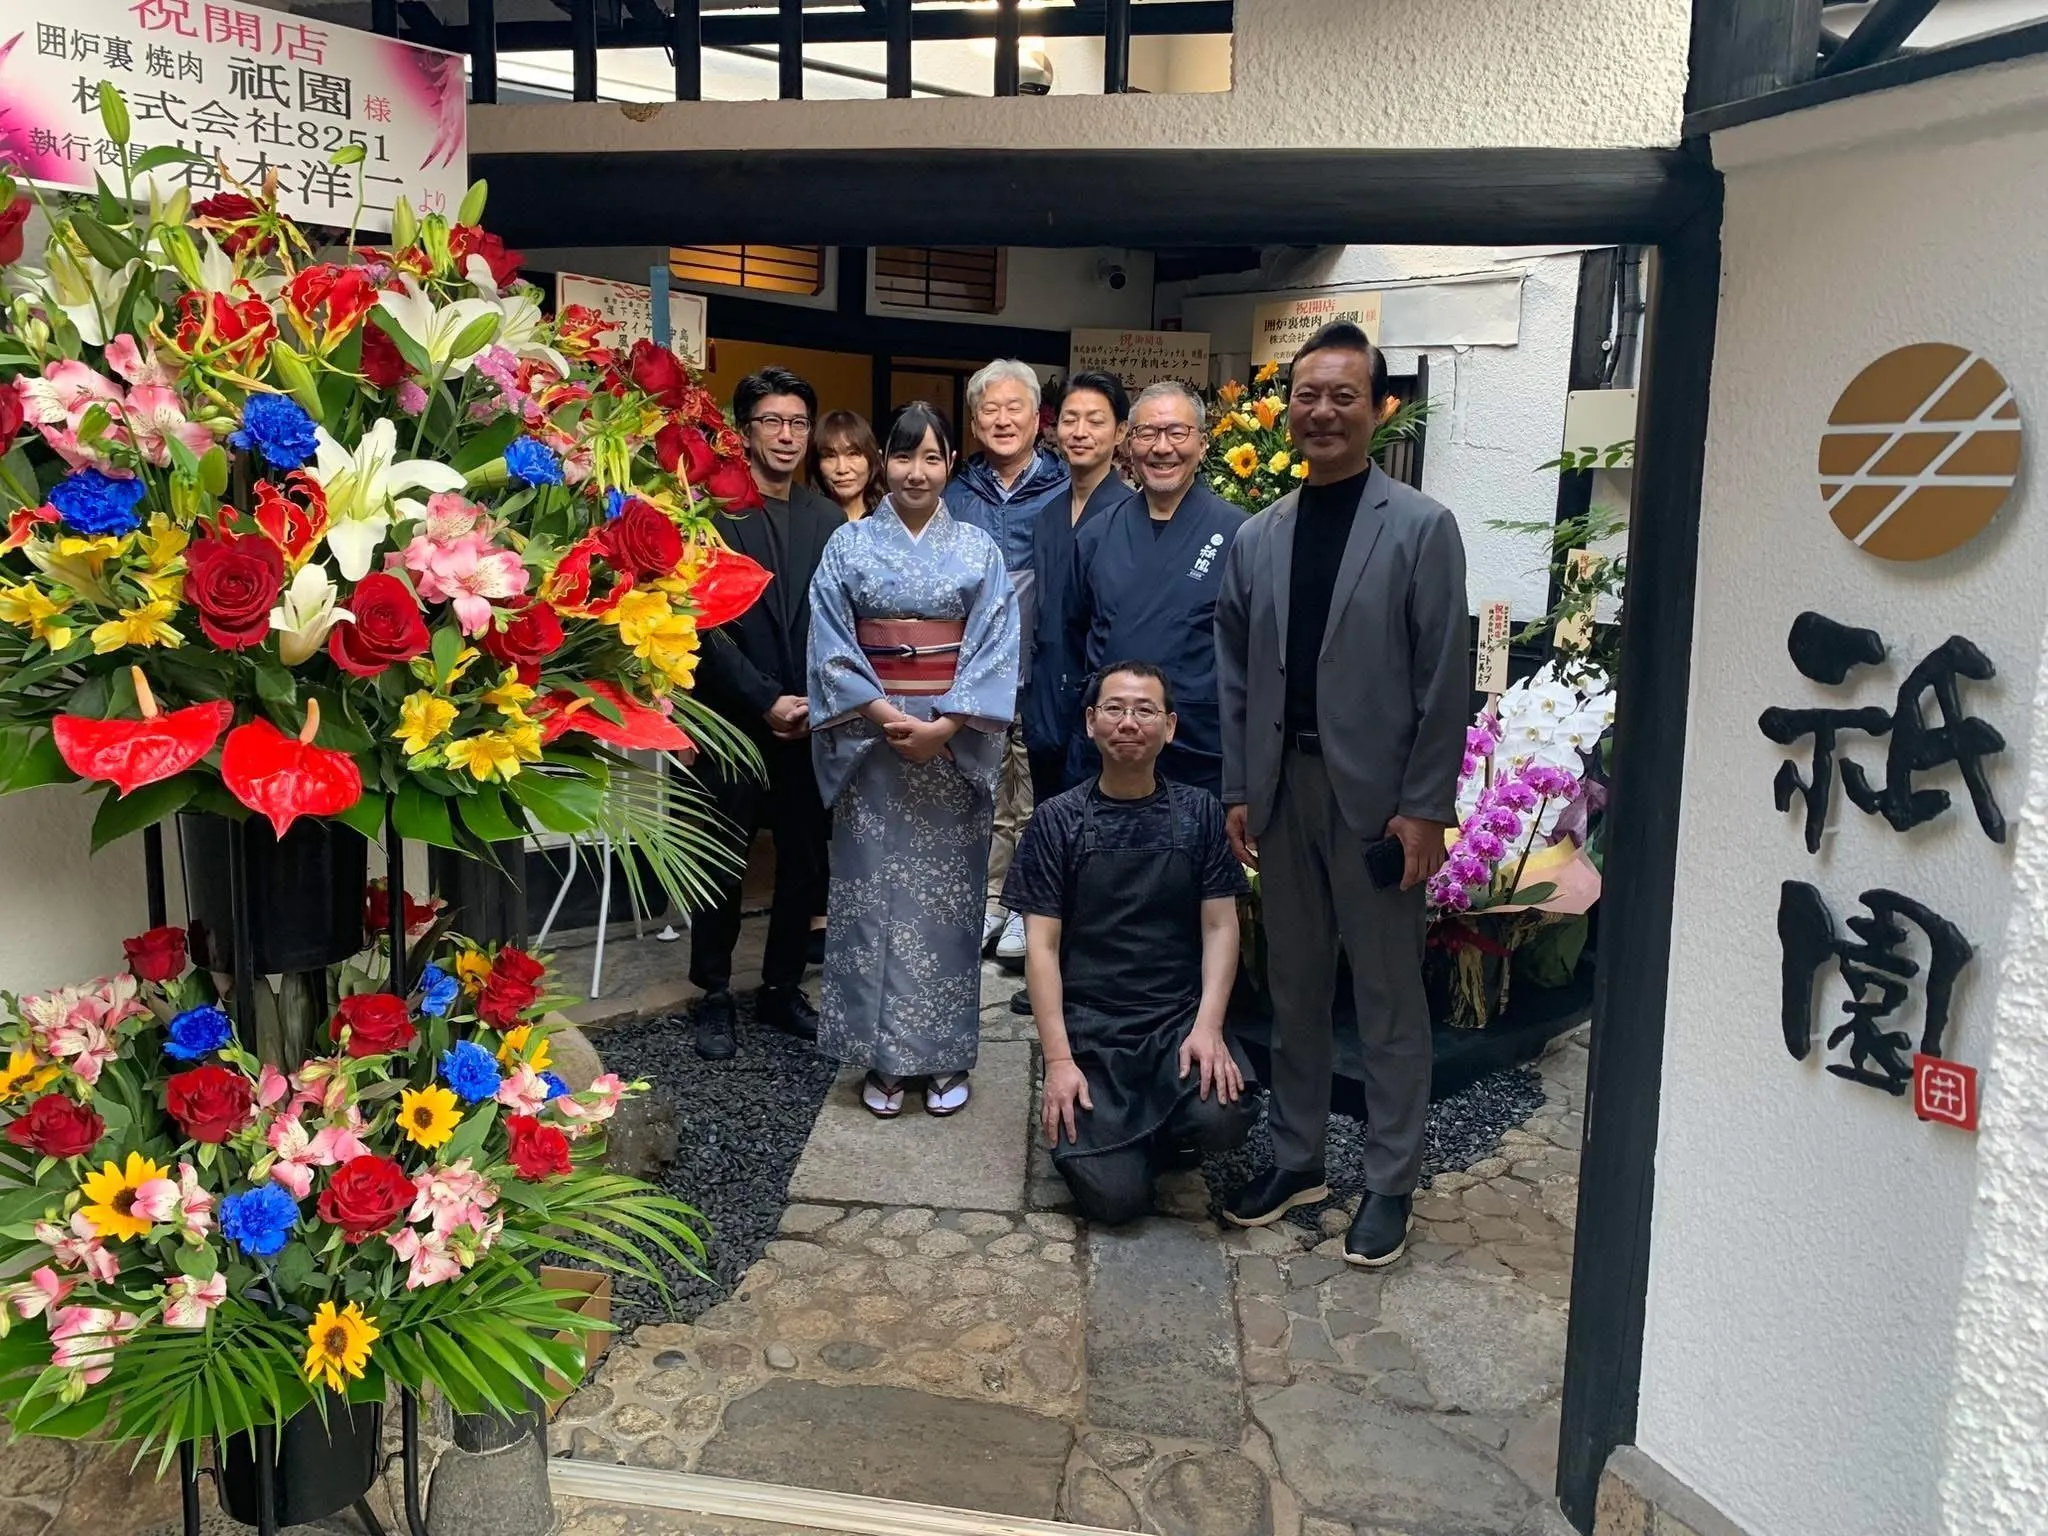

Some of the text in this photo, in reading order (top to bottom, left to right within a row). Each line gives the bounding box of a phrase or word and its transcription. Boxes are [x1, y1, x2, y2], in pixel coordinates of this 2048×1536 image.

[36, 22, 392, 124] 囲炉裏 焼肉 祇園 様
[128, 0, 328, 66] 祝開店
[418, 187, 446, 214] より
[1758, 611, 2006, 1104] 祇園
